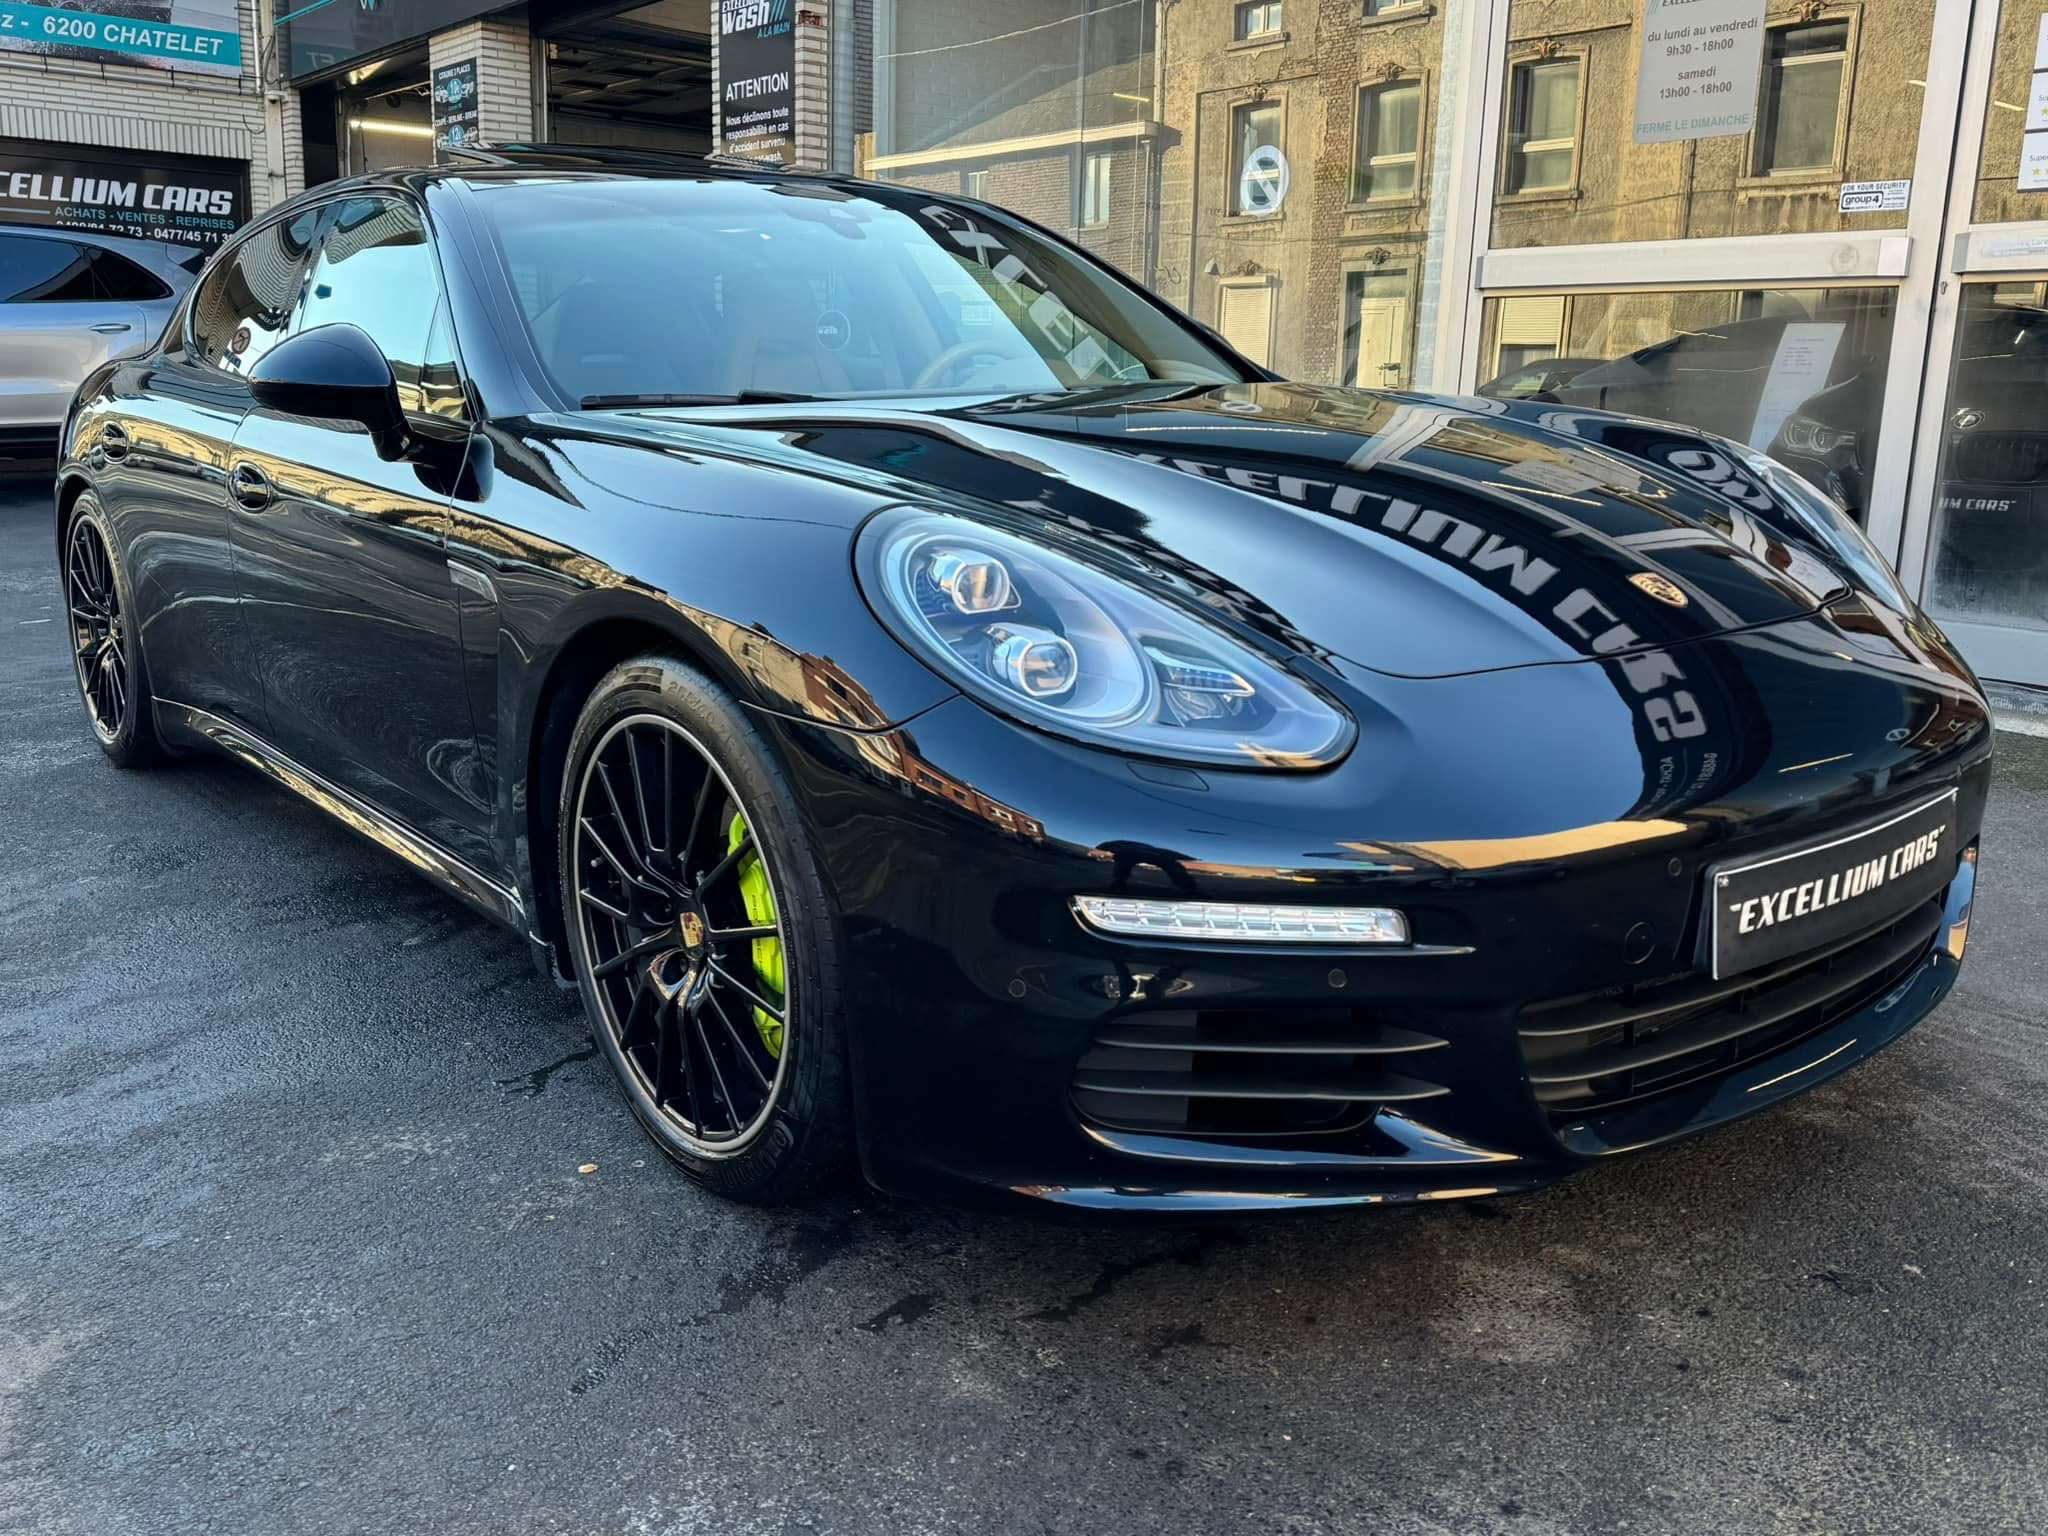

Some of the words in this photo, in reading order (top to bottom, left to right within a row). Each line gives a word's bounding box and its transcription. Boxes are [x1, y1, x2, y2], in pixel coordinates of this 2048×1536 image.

[43, 16, 96, 39] 6200
[103, 24, 223, 55] CHATELET
[1648, 31, 1661, 42] du
[1664, 27, 1690, 40] lundi
[1693, 27, 1706, 36] au
[1710, 17, 1758, 33] vendredi
[1666, 43, 1692, 56] 9h30
[1703, 38, 1734, 52] 18h00
[1678, 66, 1716, 80] samedi
[726, 71, 789, 102] ATTENTION
[1660, 86, 1690, 99] 13h00
[1700, 81, 1732, 95] 18h00
[726, 115, 741, 126] Nous
[1675, 118, 1688, 130] LE
[1691, 113, 1749, 129] DIMANCHE
[1876, 182, 1906, 190] SECURITY
[143, 184, 233, 215] CARS
[55, 206, 106, 220] ACHATS
[116, 213, 165, 225] VENTES
[176, 216, 235, 230] REPRISES
[128, 226, 142, 238] 73
[154, 228, 201, 242] 0477/45
[205, 231, 217, 243] 71
[1966, 498, 2010, 512] CARS
[1737, 854, 1887, 934] EXCELLIUM
[1889, 830, 1940, 880] CARS
